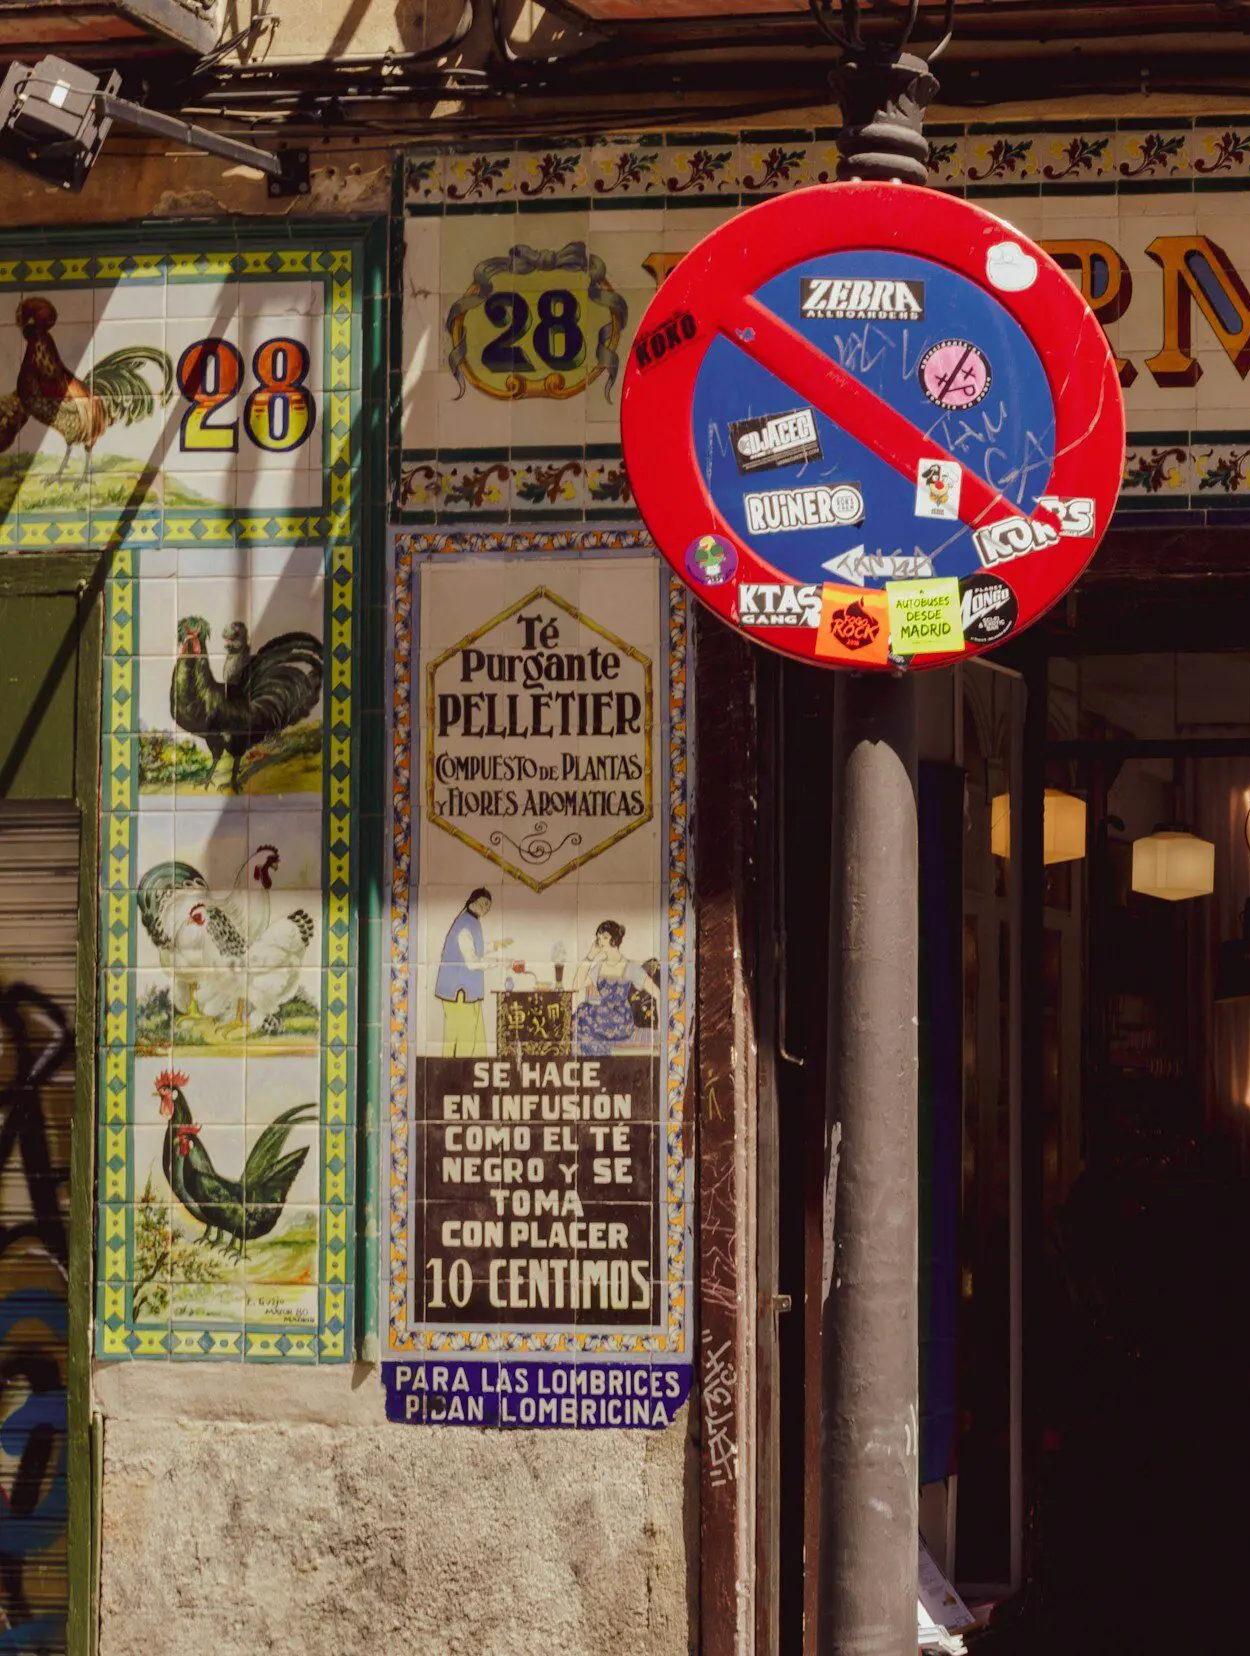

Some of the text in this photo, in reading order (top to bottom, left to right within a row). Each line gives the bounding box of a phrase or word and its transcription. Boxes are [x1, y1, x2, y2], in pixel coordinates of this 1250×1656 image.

[802, 278, 922, 312] ZEBRA
[481, 289, 588, 373] 28
[635, 312, 697, 368] KOKO
[177, 336, 317, 453] 28
[896, 596, 950, 609] AUTOBUSES
[906, 609, 942, 622] DESDE
[516, 613, 560, 650] Té
[741, 614, 798, 625] GANG
[901, 622, 952, 639] MADRID
[460, 647, 621, 690] Purgante
[438, 690, 643, 739] PELLETIER
[435, 751, 643, 784] COMPUESTO DE PLANTAS
[448, 787, 519, 817] FLORES
[521, 788, 645, 817] AROMATICAS
[473, 1062, 602, 1088] SE HACE
[443, 1088, 632, 1120] EN INFUSIÓN
[444, 1122, 631, 1152] COMO EL TÉ
[442, 1156, 633, 1184] NEGRO Y SE
[490, 1189, 584, 1217] TOMA
[441, 1220, 629, 1250] CON PLACER
[426, 1257, 651, 1310] 10 CENTIMOS
[395, 1365, 681, 1398] PARA LAS LOMBRICES
[502, 1396, 669, 1426] LOMBRICINA
